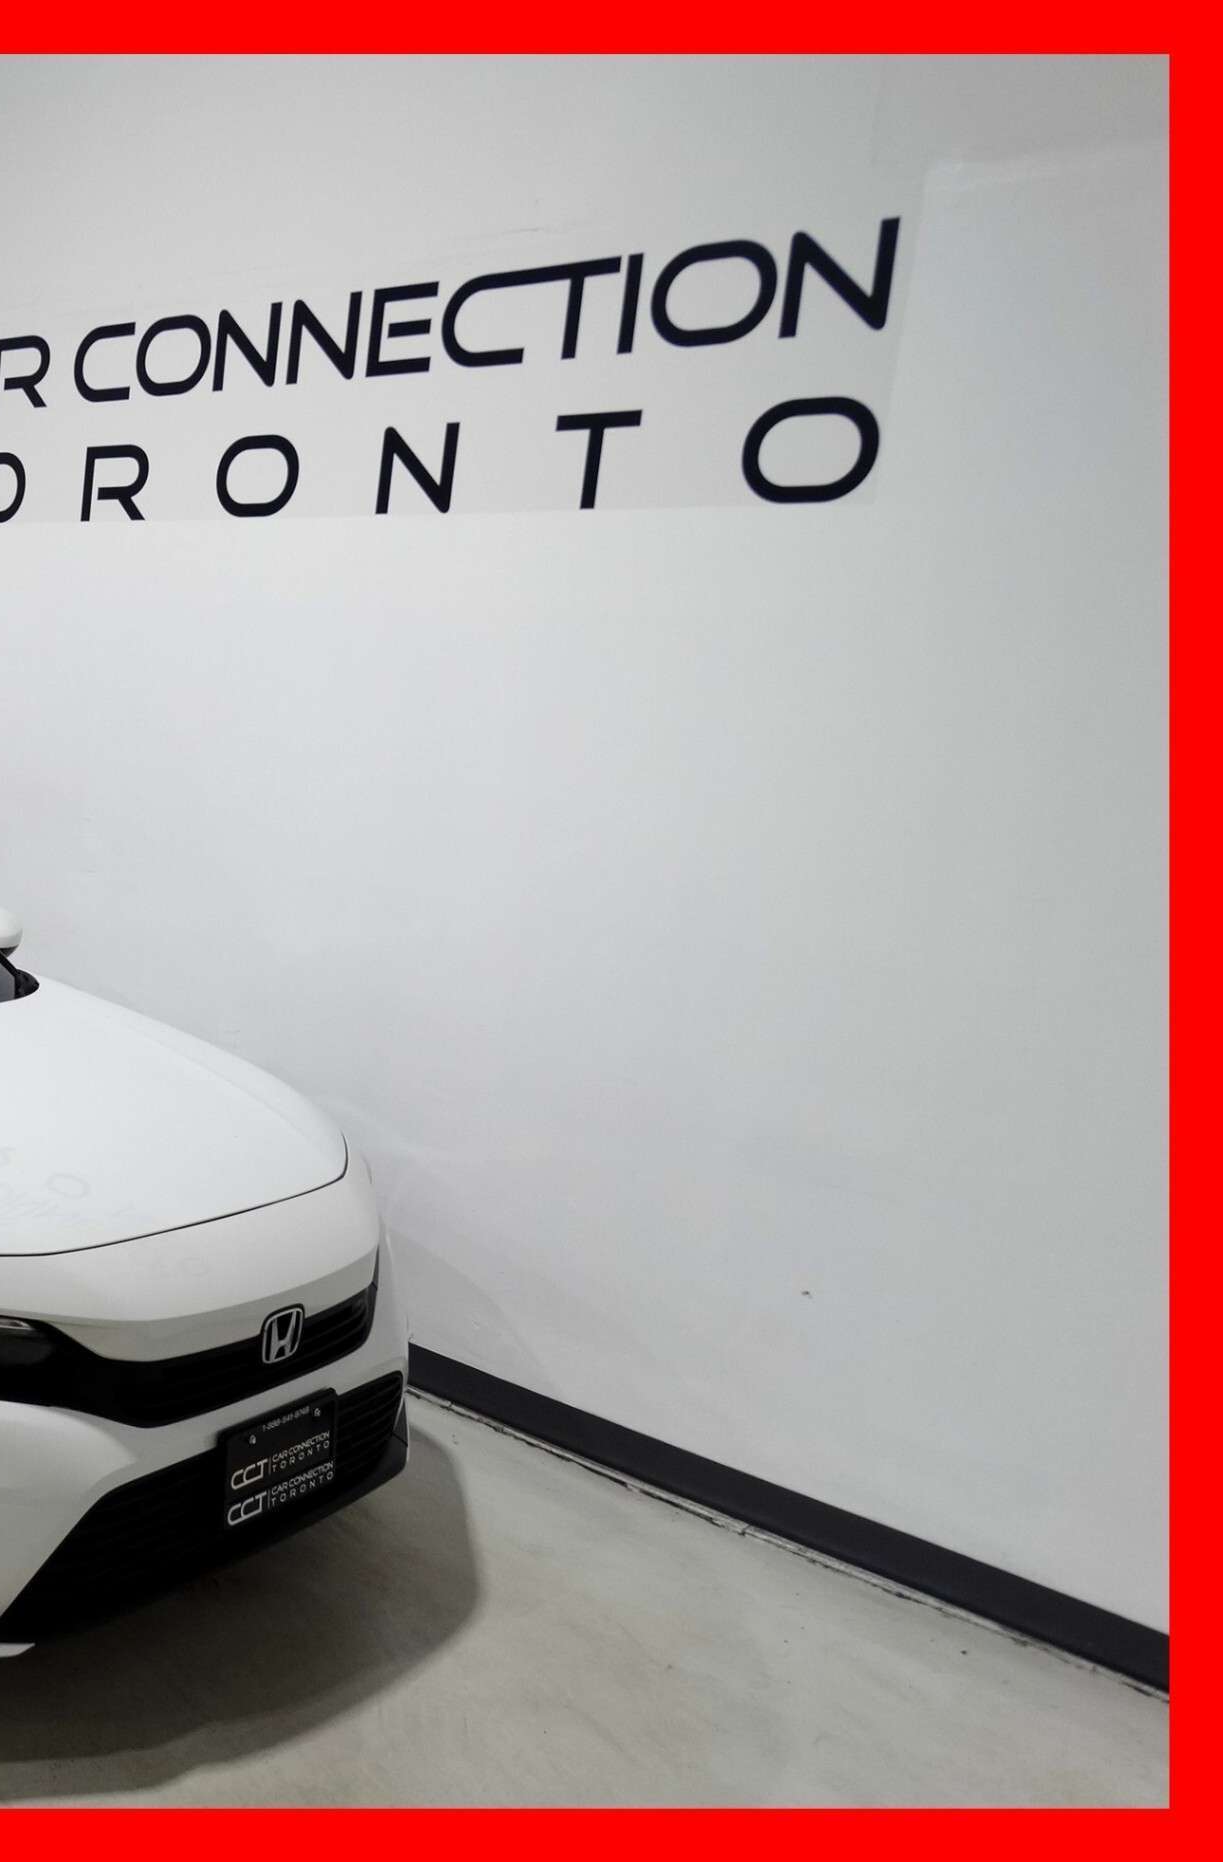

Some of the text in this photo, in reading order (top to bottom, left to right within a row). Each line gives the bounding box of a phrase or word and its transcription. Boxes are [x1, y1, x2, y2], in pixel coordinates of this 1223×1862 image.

[73, 216, 901, 403] CONNECTION
[272, 1430, 330, 1463] CAR CONNECTION
[272, 1440, 330, 1473] TORONTO
[230, 1458, 268, 1490] CCT
[271, 1460, 333, 1495] CAR CONNECTION
[271, 1471, 334, 1507] TORONTO
[227, 1491, 267, 1526] CCT
